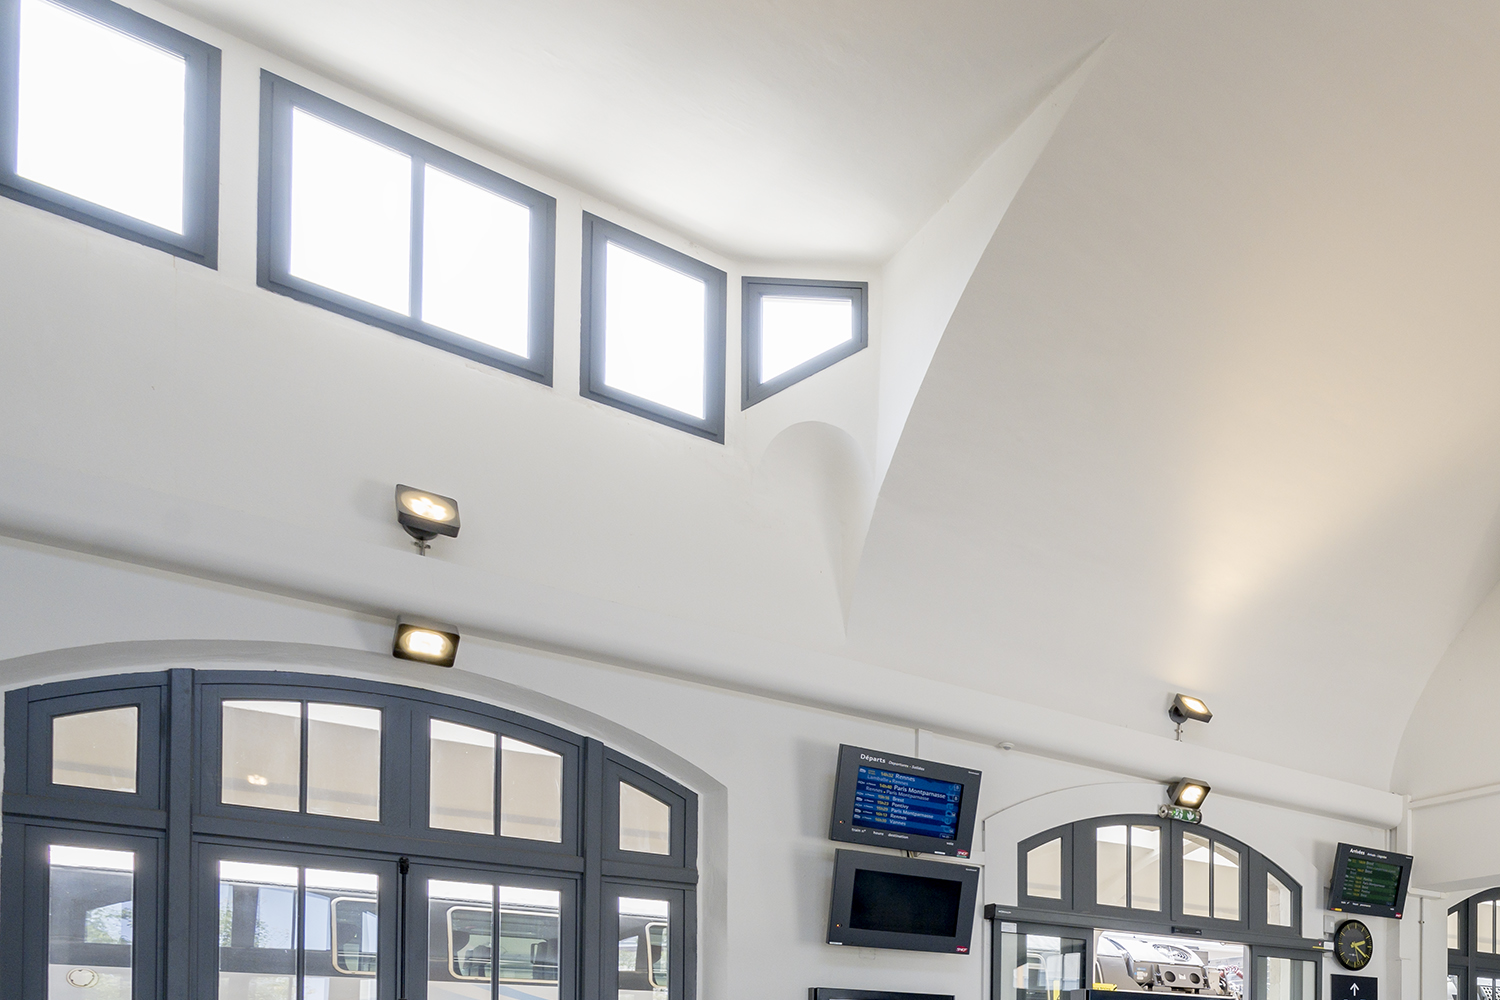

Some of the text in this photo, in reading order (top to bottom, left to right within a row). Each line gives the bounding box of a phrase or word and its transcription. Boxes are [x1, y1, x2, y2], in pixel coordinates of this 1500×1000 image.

[860, 753, 886, 764] Départs
[867, 775, 888, 783] Lamballe
[895, 773, 915, 782] Rennes
[898, 791, 929, 801] Montparnasse
[908, 787, 946, 799] Montparnasse
[891, 802, 909, 810] Pontivy
[902, 810, 934, 819] Montparnasse
